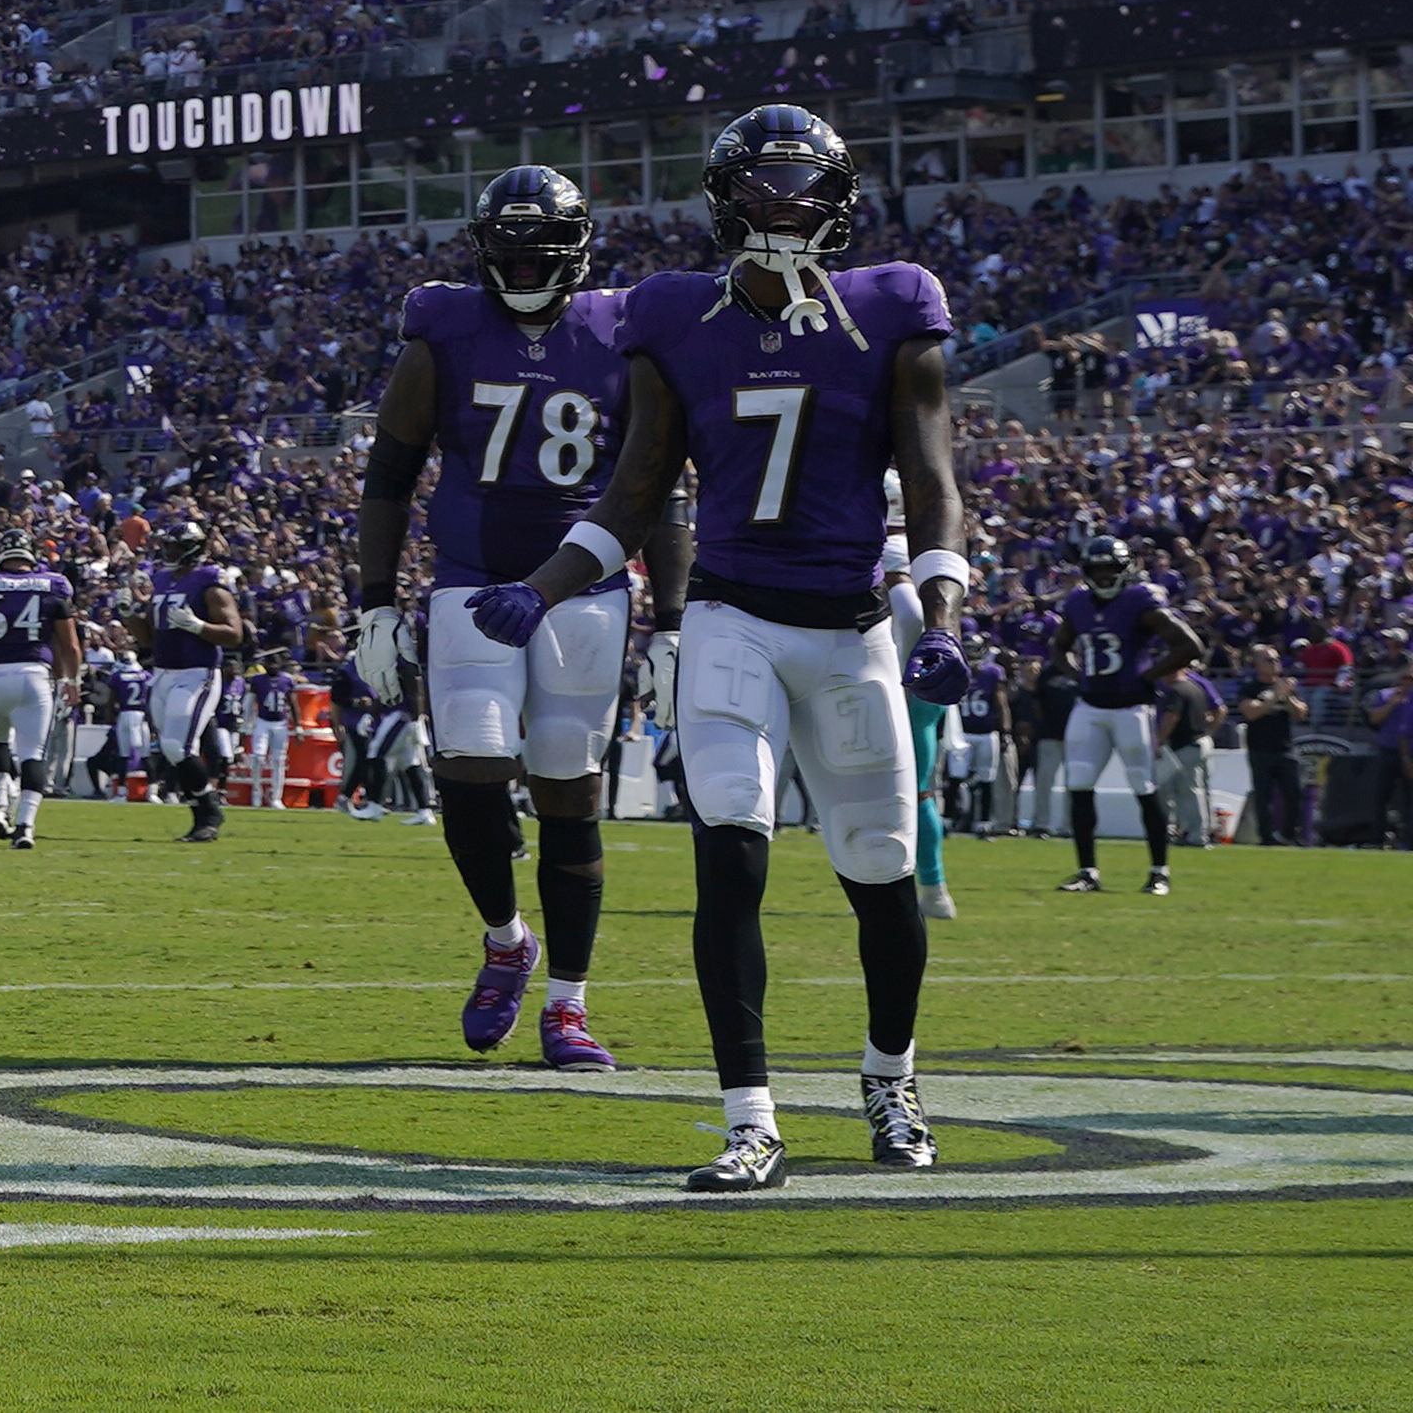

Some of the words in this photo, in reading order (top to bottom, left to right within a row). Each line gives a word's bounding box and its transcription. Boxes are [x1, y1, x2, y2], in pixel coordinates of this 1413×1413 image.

[103, 82, 364, 157] TOUCHDOWN
[747, 370, 801, 380] RAVENS
[472, 380, 598, 488] 78
[731, 386, 813, 525] 7
[1082, 632, 1124, 677] 13
